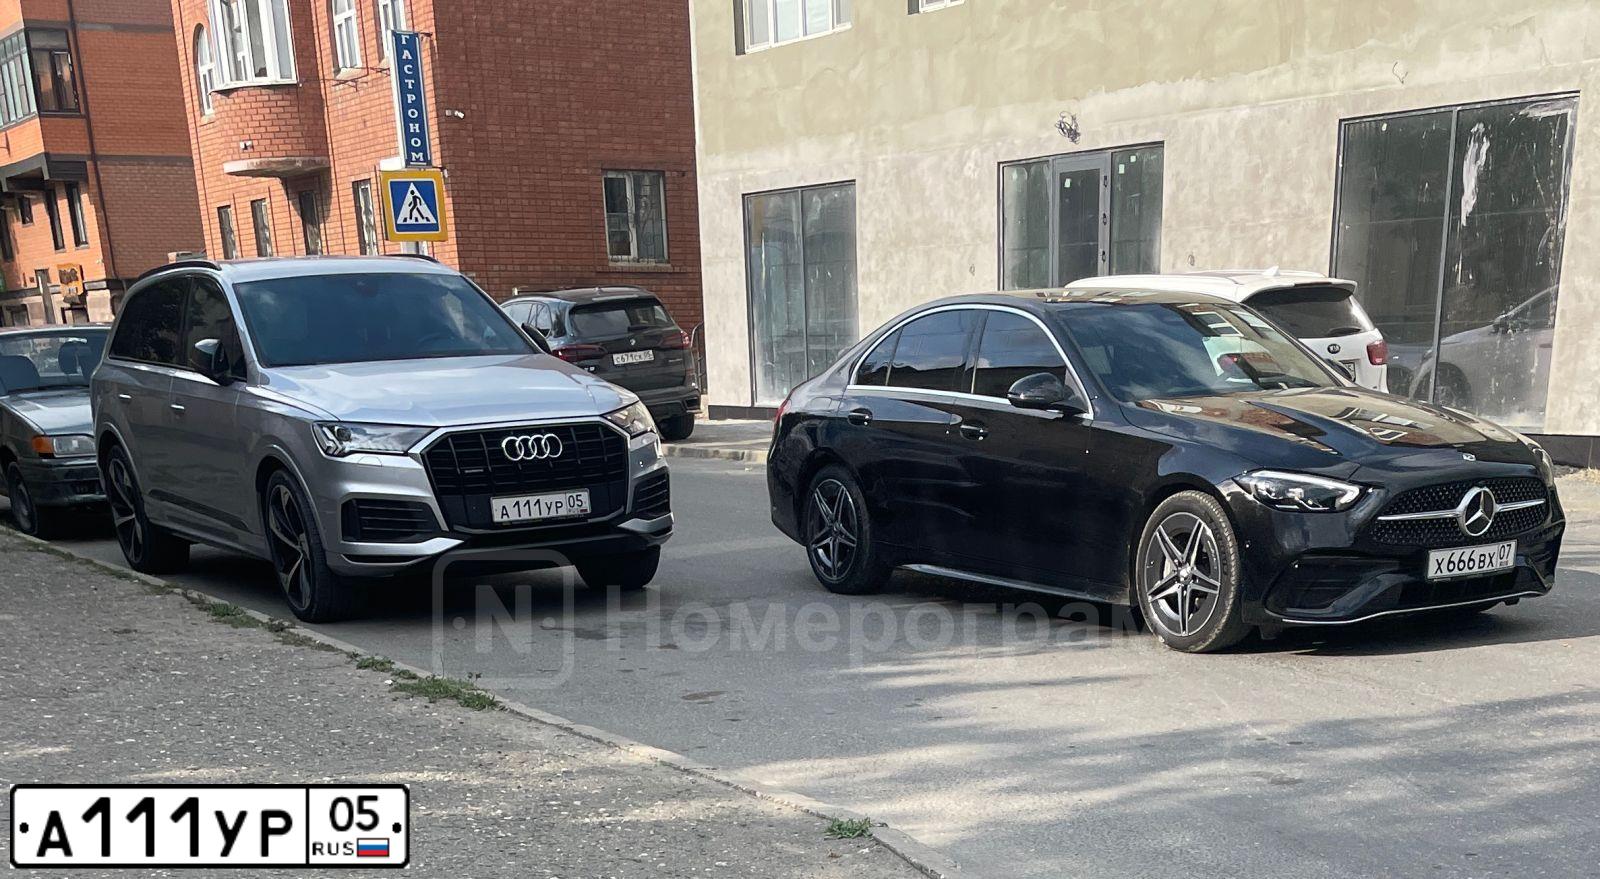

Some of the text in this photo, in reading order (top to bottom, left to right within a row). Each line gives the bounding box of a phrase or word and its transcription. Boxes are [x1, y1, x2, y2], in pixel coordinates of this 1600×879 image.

[401, 35, 425, 162] ГАСТРОНОМ
[501, 494, 583, 519] А111УР 05
[1434, 544, 1512, 575] Х666ВХ 07
